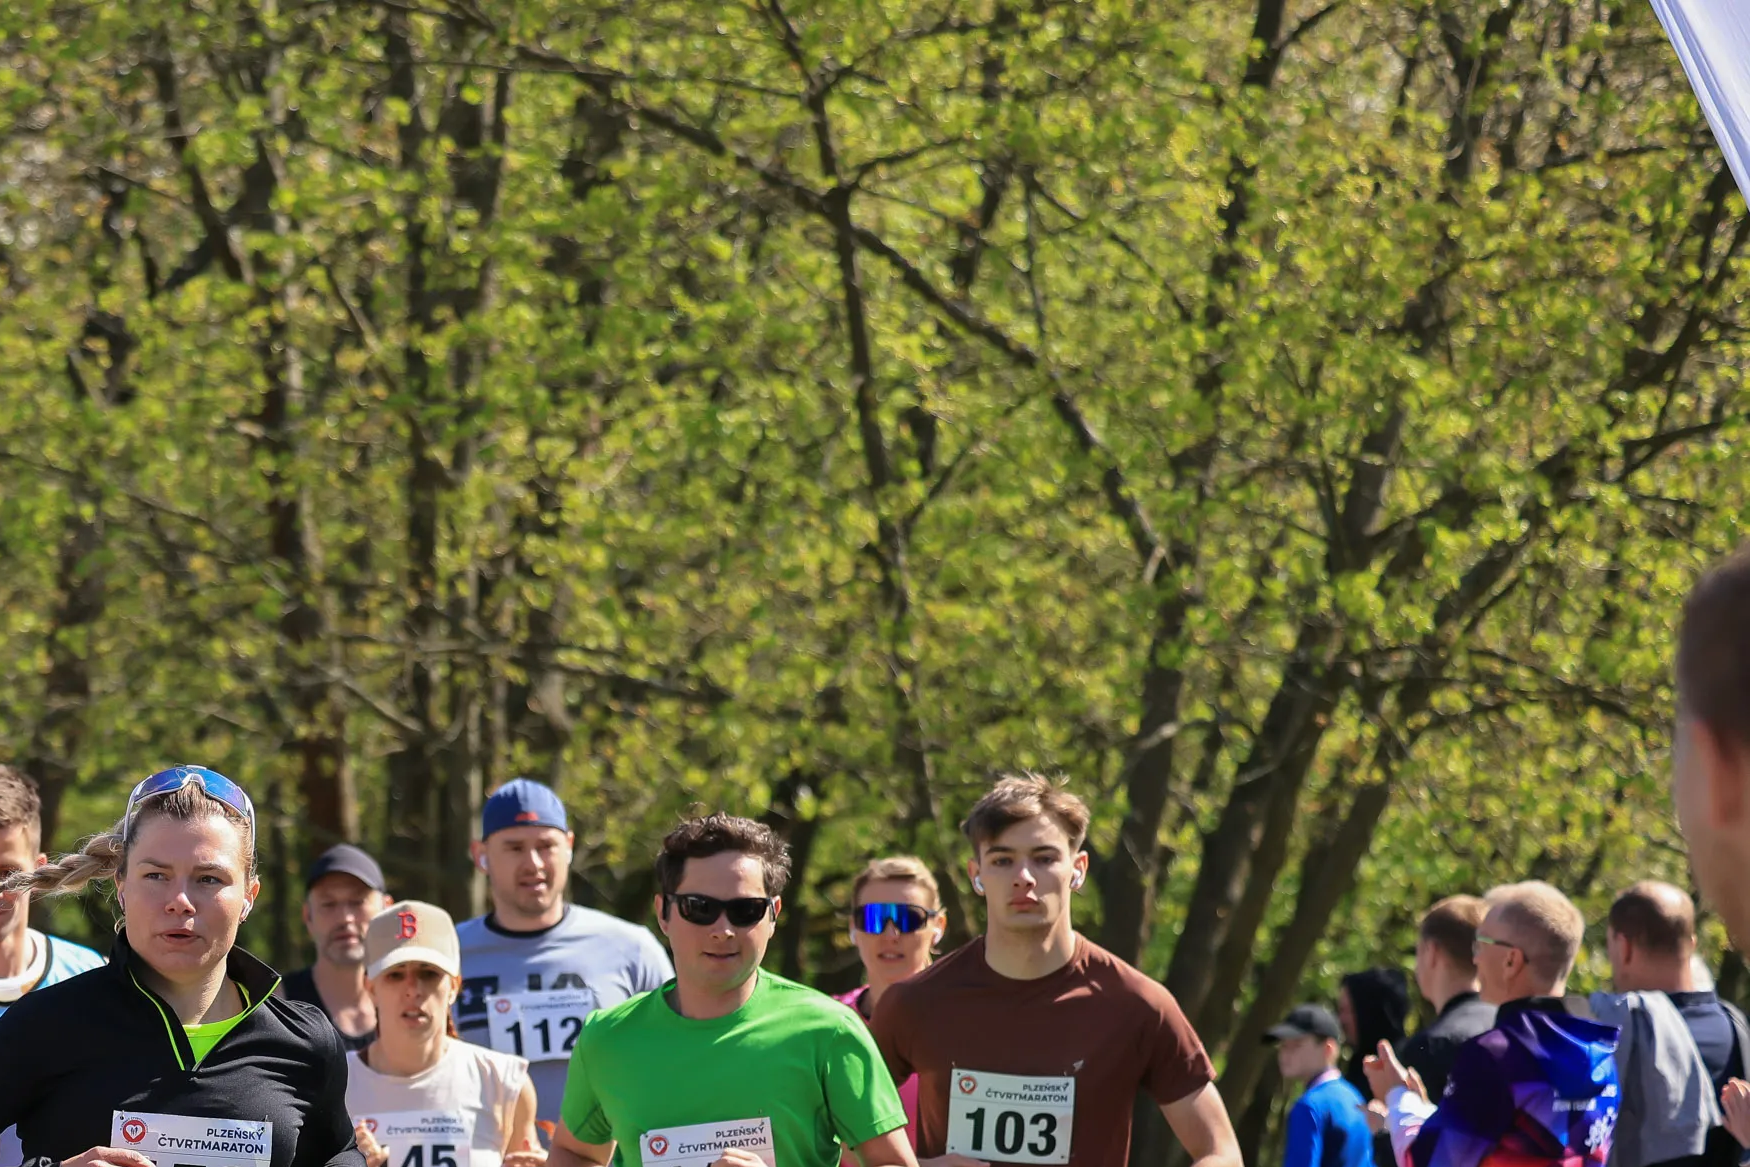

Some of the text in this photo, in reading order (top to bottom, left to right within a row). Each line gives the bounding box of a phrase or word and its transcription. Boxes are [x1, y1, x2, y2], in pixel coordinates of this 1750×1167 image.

[395, 911, 417, 939] B
[985, 1088, 1068, 1102] ČTVRTMARATON
[206, 1127, 264, 1141] PLZEŇSKÝ
[715, 1126, 765, 1139] PLZEŇSKÝ
[965, 1107, 1058, 1157] 103
[157, 1134, 264, 1155] ČTVRTMARATON
[678, 1137, 767, 1154] ČTVRTMARATON
